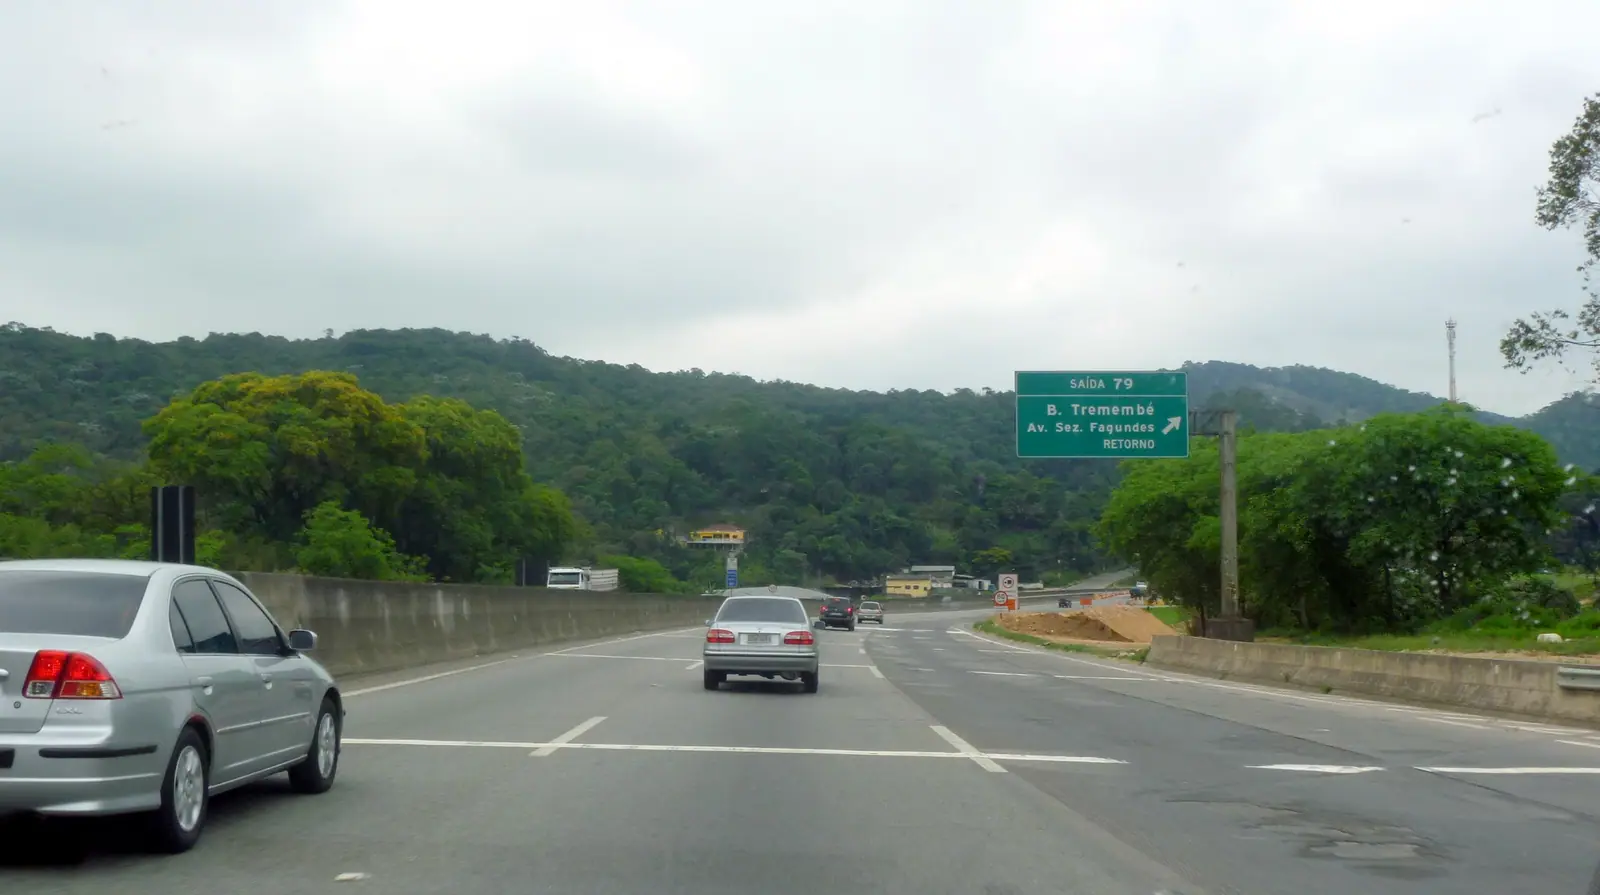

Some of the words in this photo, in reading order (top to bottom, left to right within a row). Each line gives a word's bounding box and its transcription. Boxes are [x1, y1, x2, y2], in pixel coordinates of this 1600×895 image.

[1070, 376, 1105, 389] SAÍDA
[1113, 378, 1134, 390] 79
[1047, 404, 1062, 416] B.
[1071, 401, 1155, 416] Tremembé
[1027, 422, 1048, 433] Av.
[1055, 422, 1083, 433] Sez.
[1090, 422, 1155, 434] Fagundes
[1104, 439, 1155, 449] RETORNO
